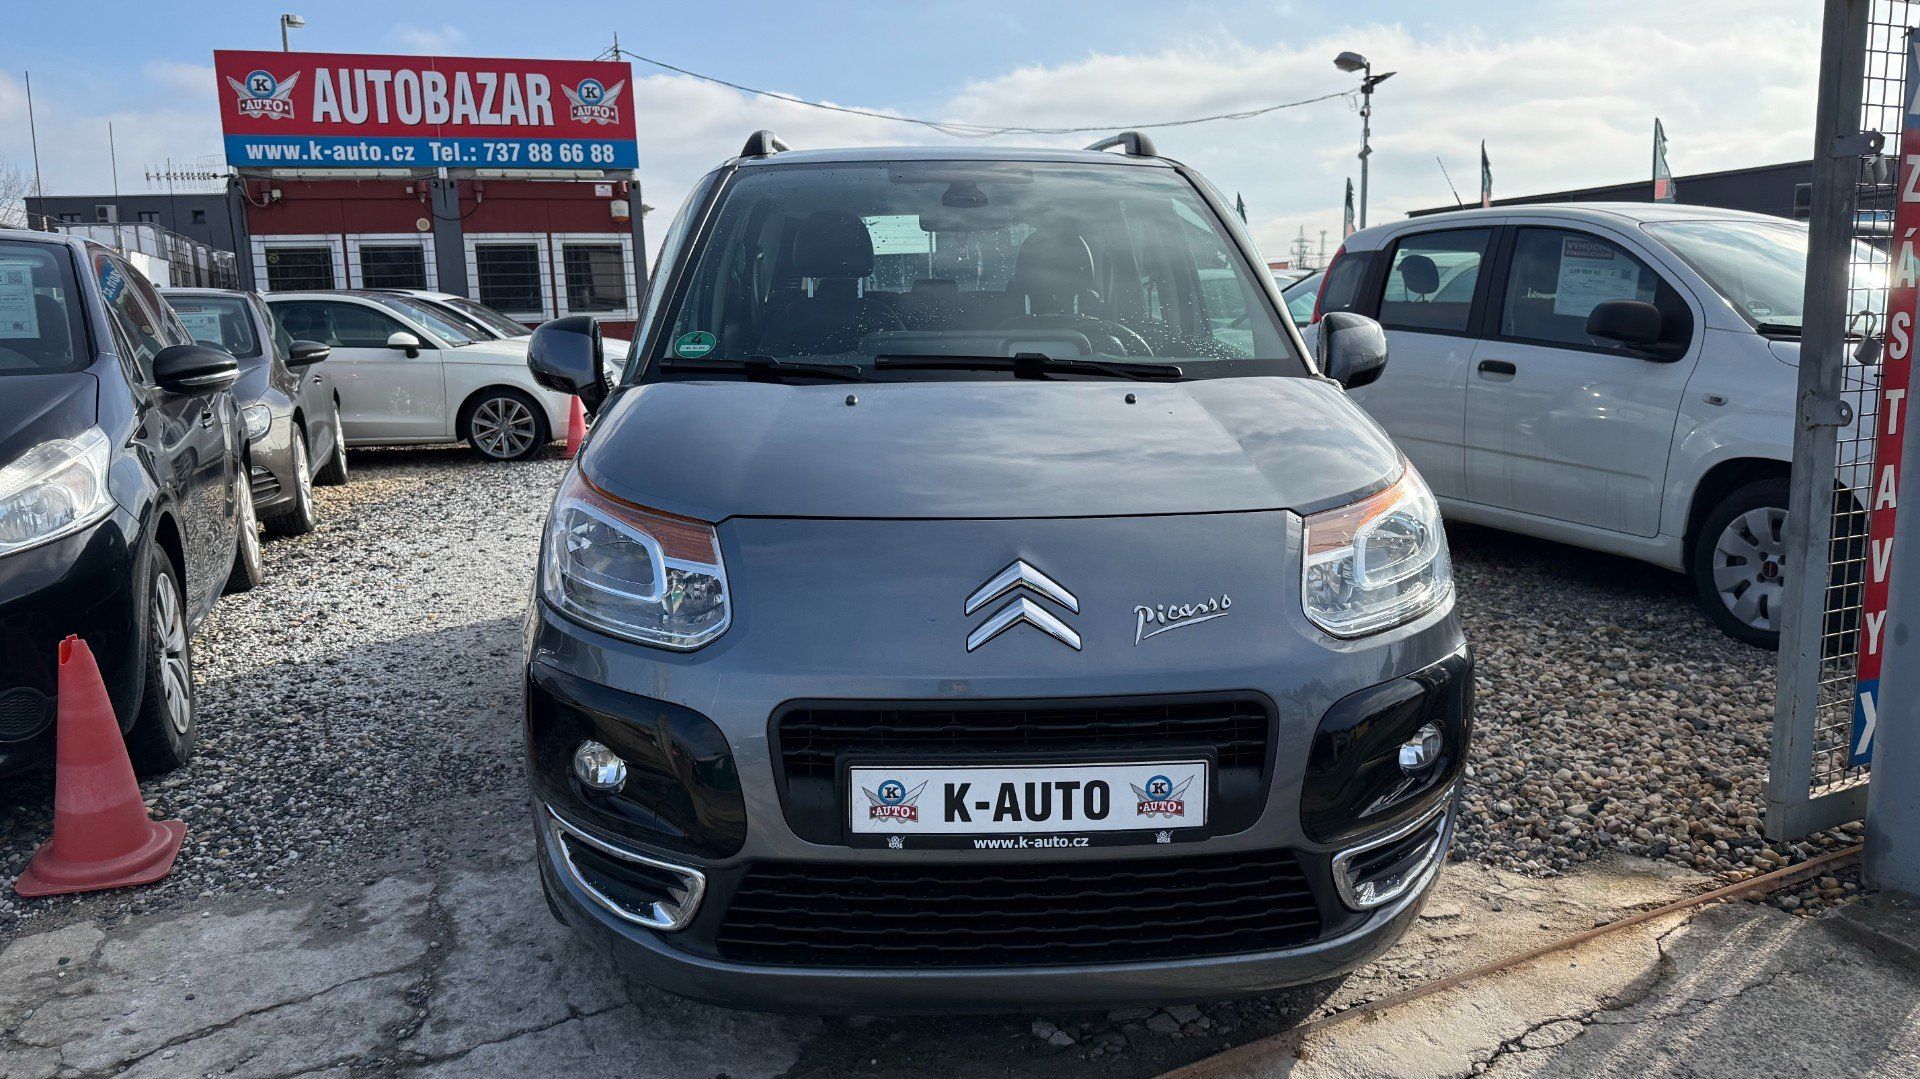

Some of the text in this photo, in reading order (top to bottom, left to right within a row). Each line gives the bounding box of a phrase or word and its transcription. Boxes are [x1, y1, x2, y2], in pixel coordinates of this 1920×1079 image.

[253, 79, 269, 92] K
[311, 68, 554, 126] AUTOBAZAR
[584, 86, 598, 99] K
[245, 99, 283, 112] AUTO
[577, 106, 610, 118] AUTO
[245, 140, 615, 163] www.k-auto.cz Tel.: 737 88 66 88
[691, 333, 702, 344] 4
[885, 787, 899, 798] K
[1152, 782, 1166, 794] K
[944, 780, 1110, 822] K-AUTO
[1142, 801, 1176, 813] AUTO
[875, 807, 911, 818] AUTO
[973, 836, 1089, 849] www.k-auto.cz
